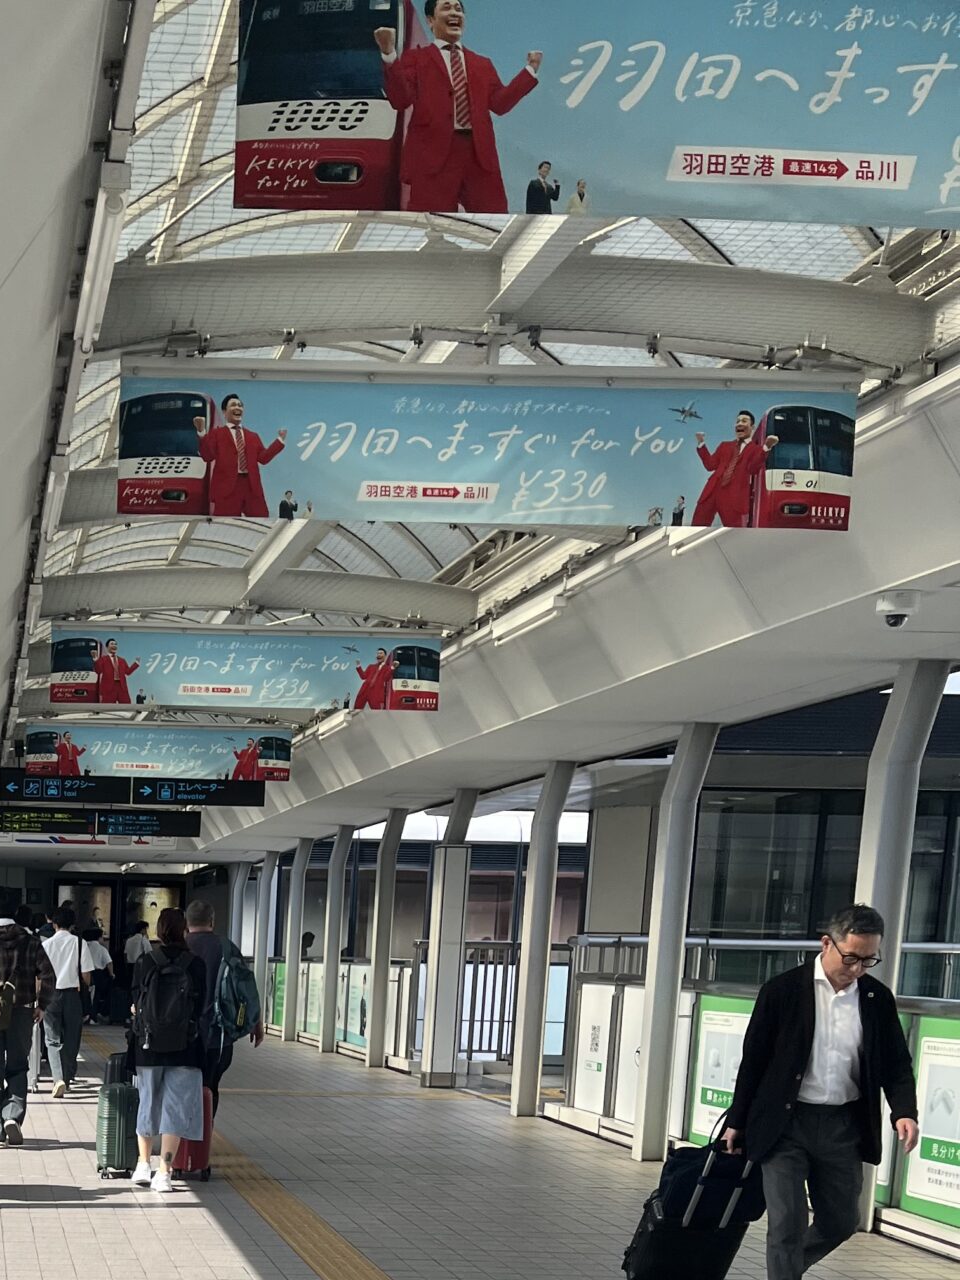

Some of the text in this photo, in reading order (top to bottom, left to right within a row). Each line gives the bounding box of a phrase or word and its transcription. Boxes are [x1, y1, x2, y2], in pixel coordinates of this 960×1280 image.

[268, 101, 369, 132] 1000
[245, 155, 318, 175] KEIKYU
[682, 153, 897, 182] 羽田空港 最速14分 品川
[257, 174, 308, 191] for You
[571, 428, 622, 458] for
[630, 425, 684, 457] You
[135, 457, 191, 475] 1000
[366, 484, 418, 499] 羽田空港
[464, 486, 488, 499] 品川
[321, 655, 350, 671] You
[64, 780, 96, 788] タクシー
[178, 782, 225, 791] エレベーター
